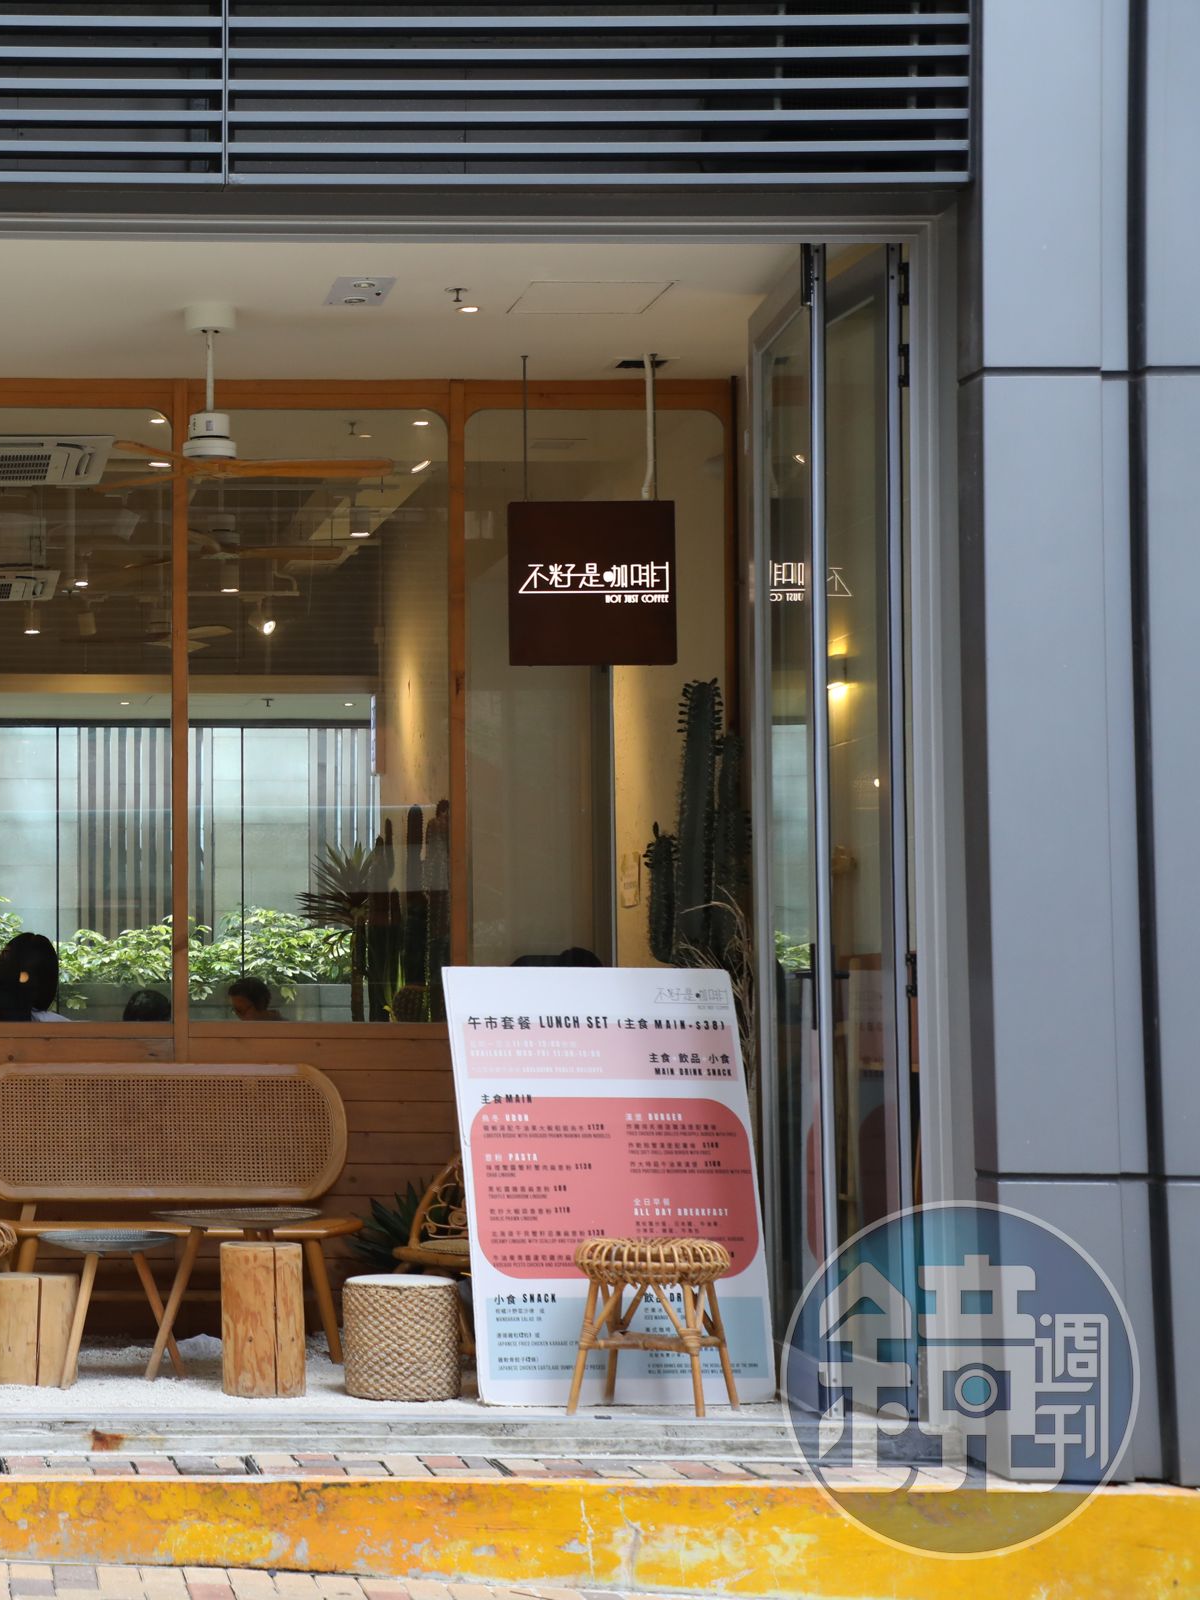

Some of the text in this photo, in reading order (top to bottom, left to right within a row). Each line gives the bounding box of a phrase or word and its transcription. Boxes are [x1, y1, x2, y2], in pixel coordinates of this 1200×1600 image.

[605, 594, 669, 604] NOT JUST COFFEE
[468, 1015, 531, 1030] 午市套餐
[539, 1015, 580, 1029] LUNCH
[587, 1016, 608, 1029] SET
[649, 1053, 670, 1063] 主食
[708, 1053, 730, 1064] 小食
[707, 1068, 732, 1077] SNACK
[508, 1152, 538, 1161] PASTA
[634, 1208, 729, 1217] ALL DAY BREAKFAST
[494, 1293, 557, 1305] 小食 SNACK
